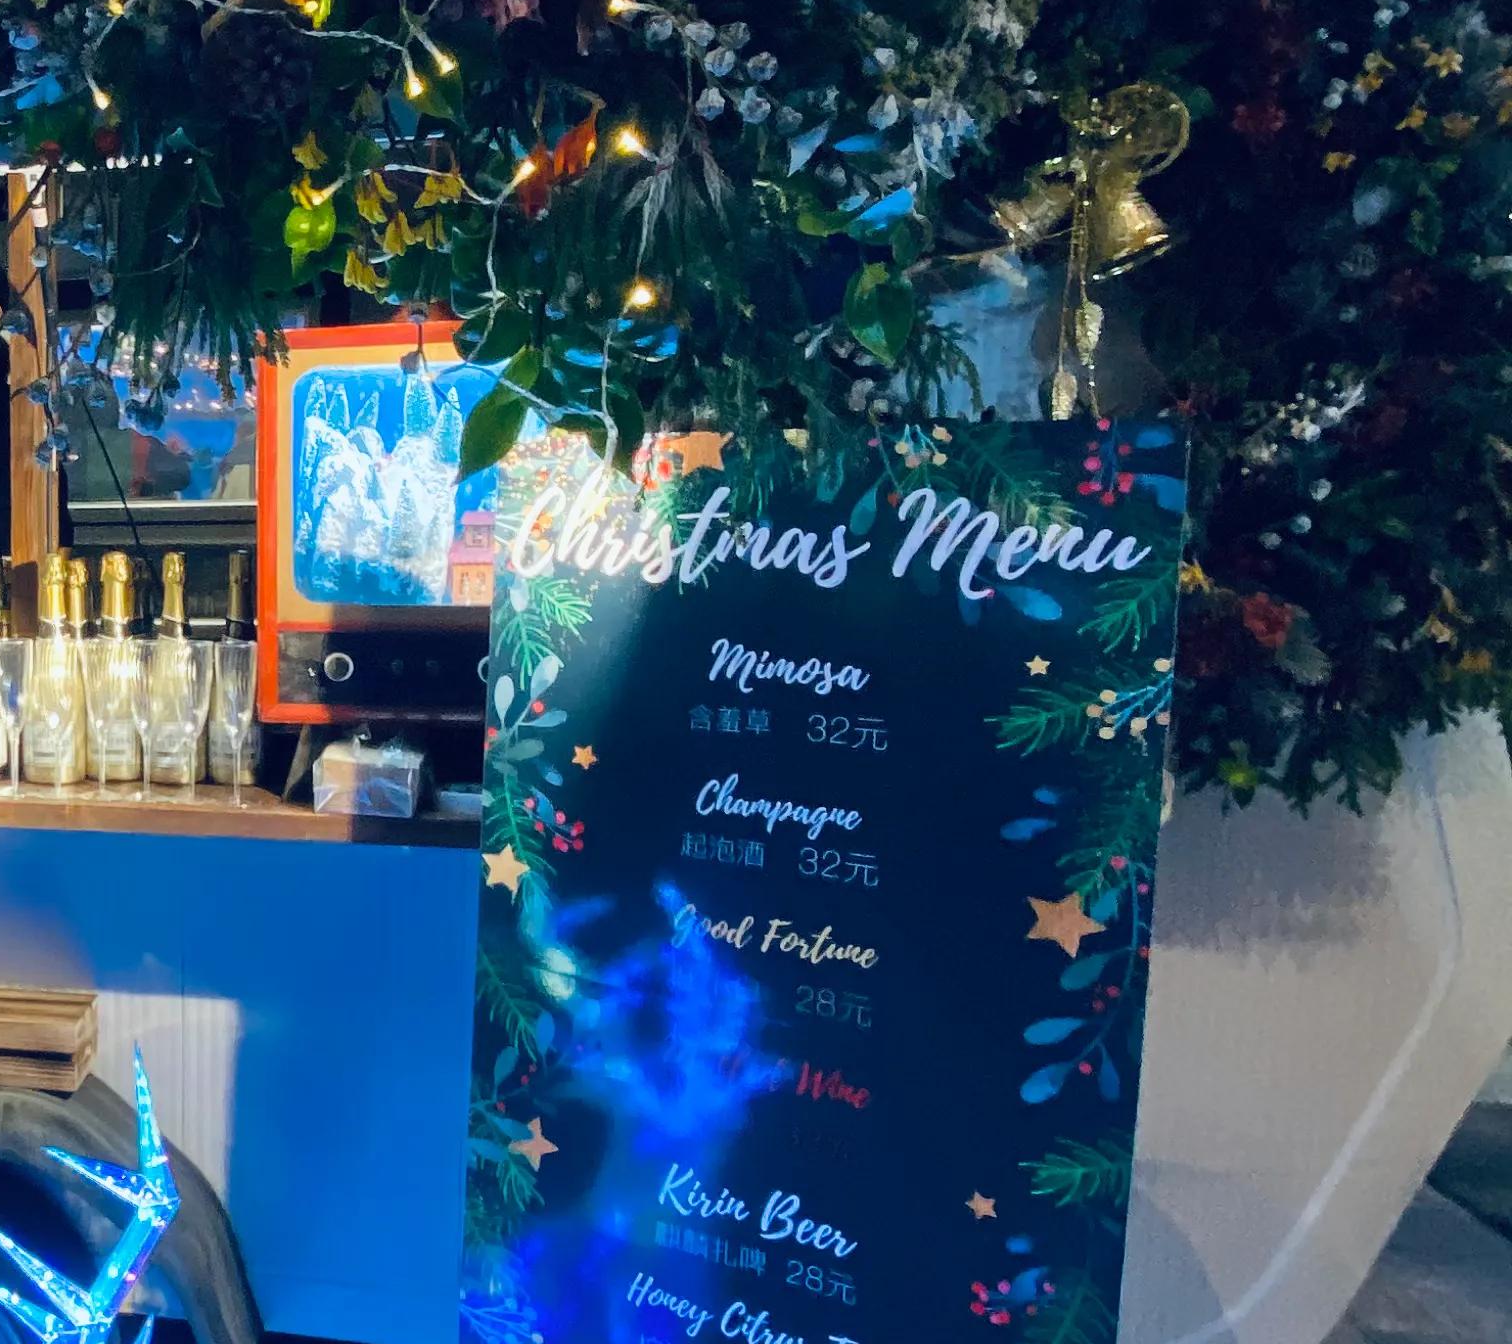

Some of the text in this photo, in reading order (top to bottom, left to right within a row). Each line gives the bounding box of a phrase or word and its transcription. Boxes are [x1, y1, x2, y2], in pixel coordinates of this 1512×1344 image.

[510, 462, 1152, 600] Christmas Menu
[708, 637, 871, 695] Mimosa
[806, 713, 888, 751] 32元
[695, 773, 863, 841] Champagne
[798, 846, 879, 887] 32元
[760, 918, 880, 969] Fortune
[658, 1163, 858, 1258] Kirin Beer
[627, 1272, 714, 1337] Honey
[786, 1259, 857, 1306] 28元
